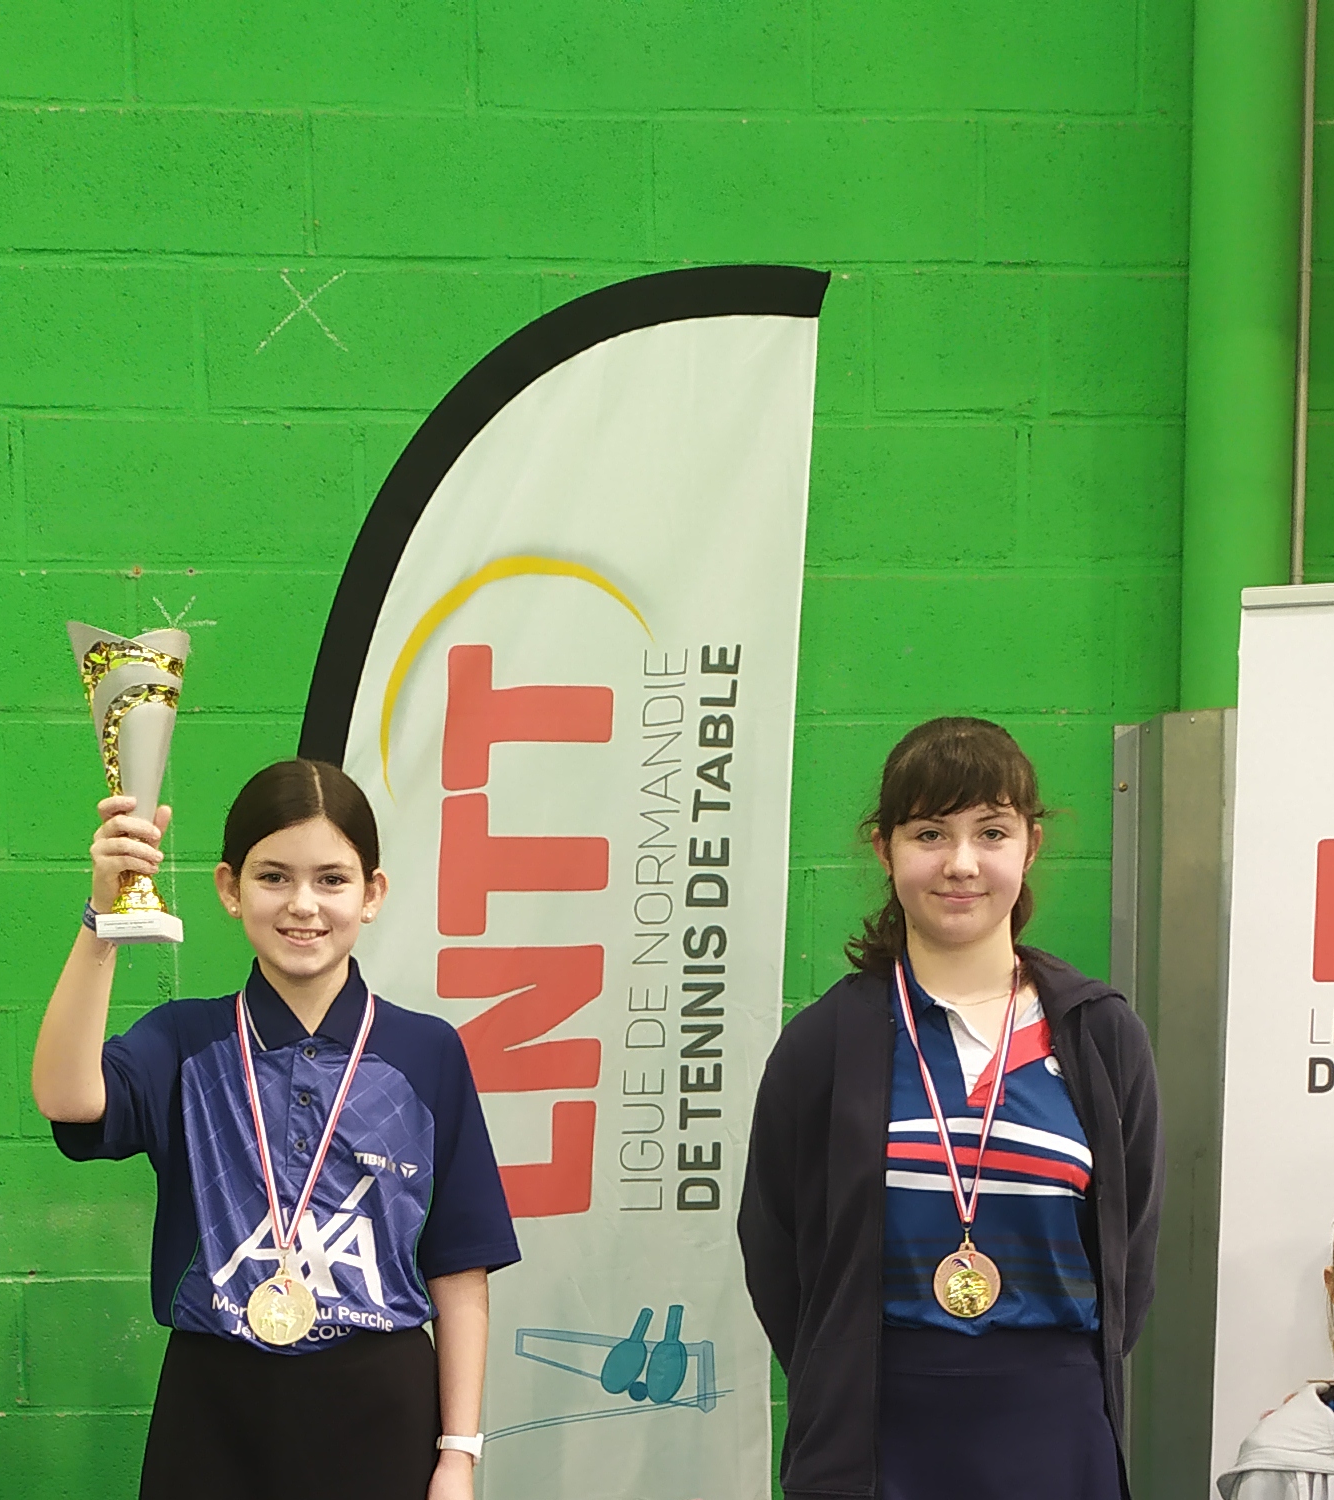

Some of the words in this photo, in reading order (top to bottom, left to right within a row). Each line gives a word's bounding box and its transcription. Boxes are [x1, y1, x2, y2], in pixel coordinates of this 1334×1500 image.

[691, 643, 742, 823] TABLE
[631, 648, 688, 965] NORMANDIE
[685, 837, 730, 908] DE
[436, 645, 614, 1218] LNTT
[625, 985, 669, 1049] DE
[679, 925, 727, 1131] TENNIS
[619, 1068, 665, 1211] LIGUE
[677, 1142, 721, 1211] DE
[212, 1176, 387, 1309] AXA
[337, 1305, 394, 1333] Perche
